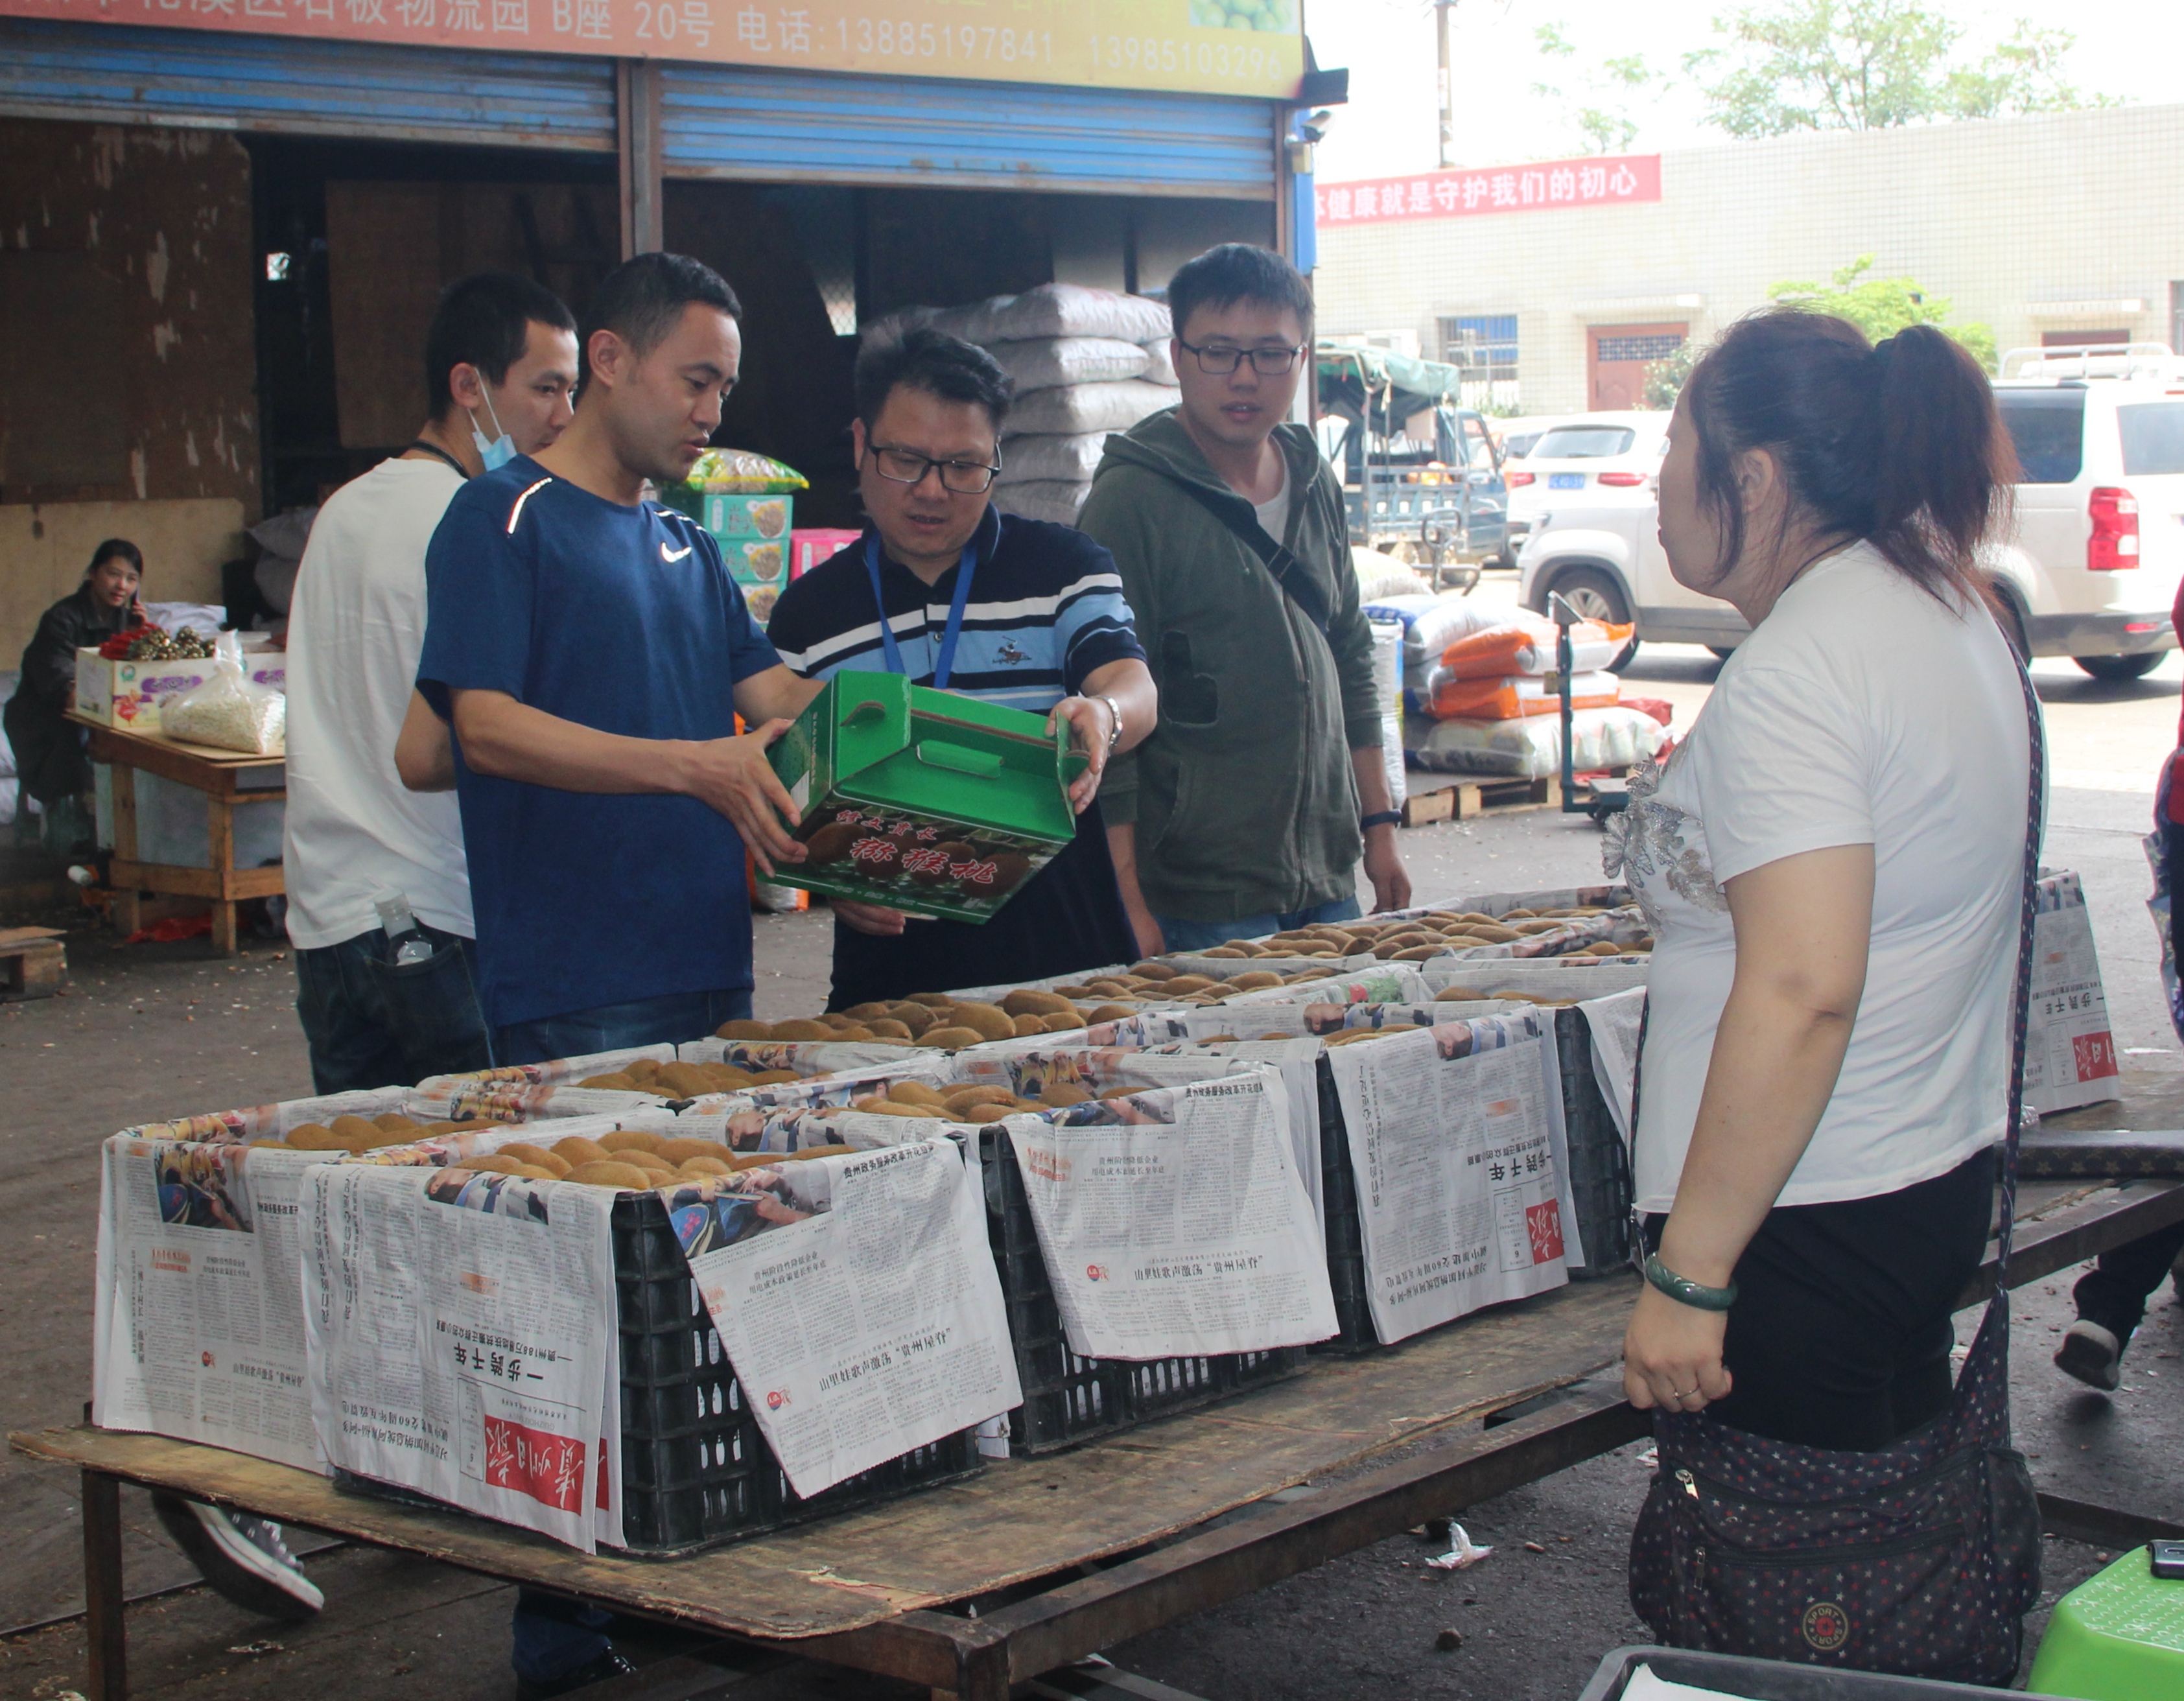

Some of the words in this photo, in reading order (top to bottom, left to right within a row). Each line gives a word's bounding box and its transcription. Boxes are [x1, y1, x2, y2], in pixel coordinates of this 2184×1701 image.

[16, 0, 529, 34] 区石板物流园
[553, 0, 614, 40] B座
[636, 4, 714, 47] 20号
[1089, 35, 1282, 81] 13985103296
[836, 809, 938, 841] 修文贵长
[849, 836, 998, 884] 猕猴桃
[454, 1343, 543, 1382] 一步跨千年
[1807, 1607, 1839, 1625] SPORT
[1811, 1627, 1843, 1645] SPORT
